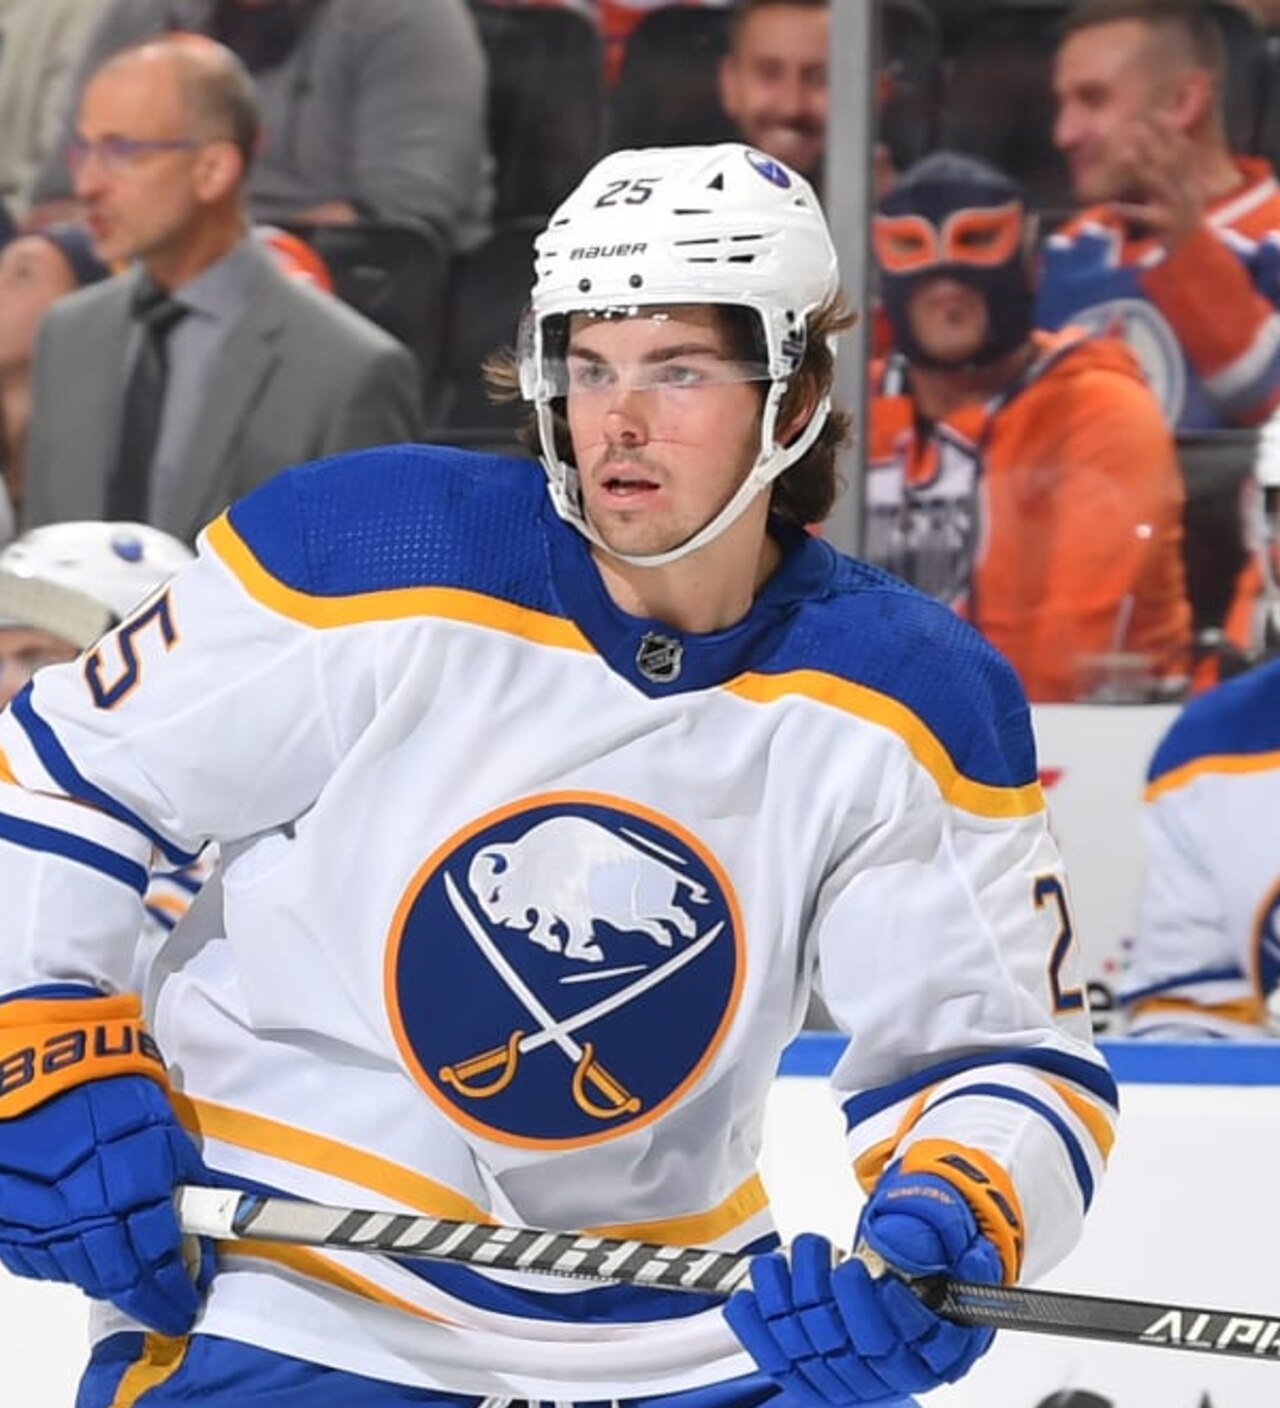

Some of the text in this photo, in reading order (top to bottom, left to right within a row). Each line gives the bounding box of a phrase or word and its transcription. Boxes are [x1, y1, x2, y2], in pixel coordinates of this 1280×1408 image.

[593, 176, 662, 209] 25
[569, 241, 648, 261] BAUER
[1033, 872, 1086, 1016] 2
